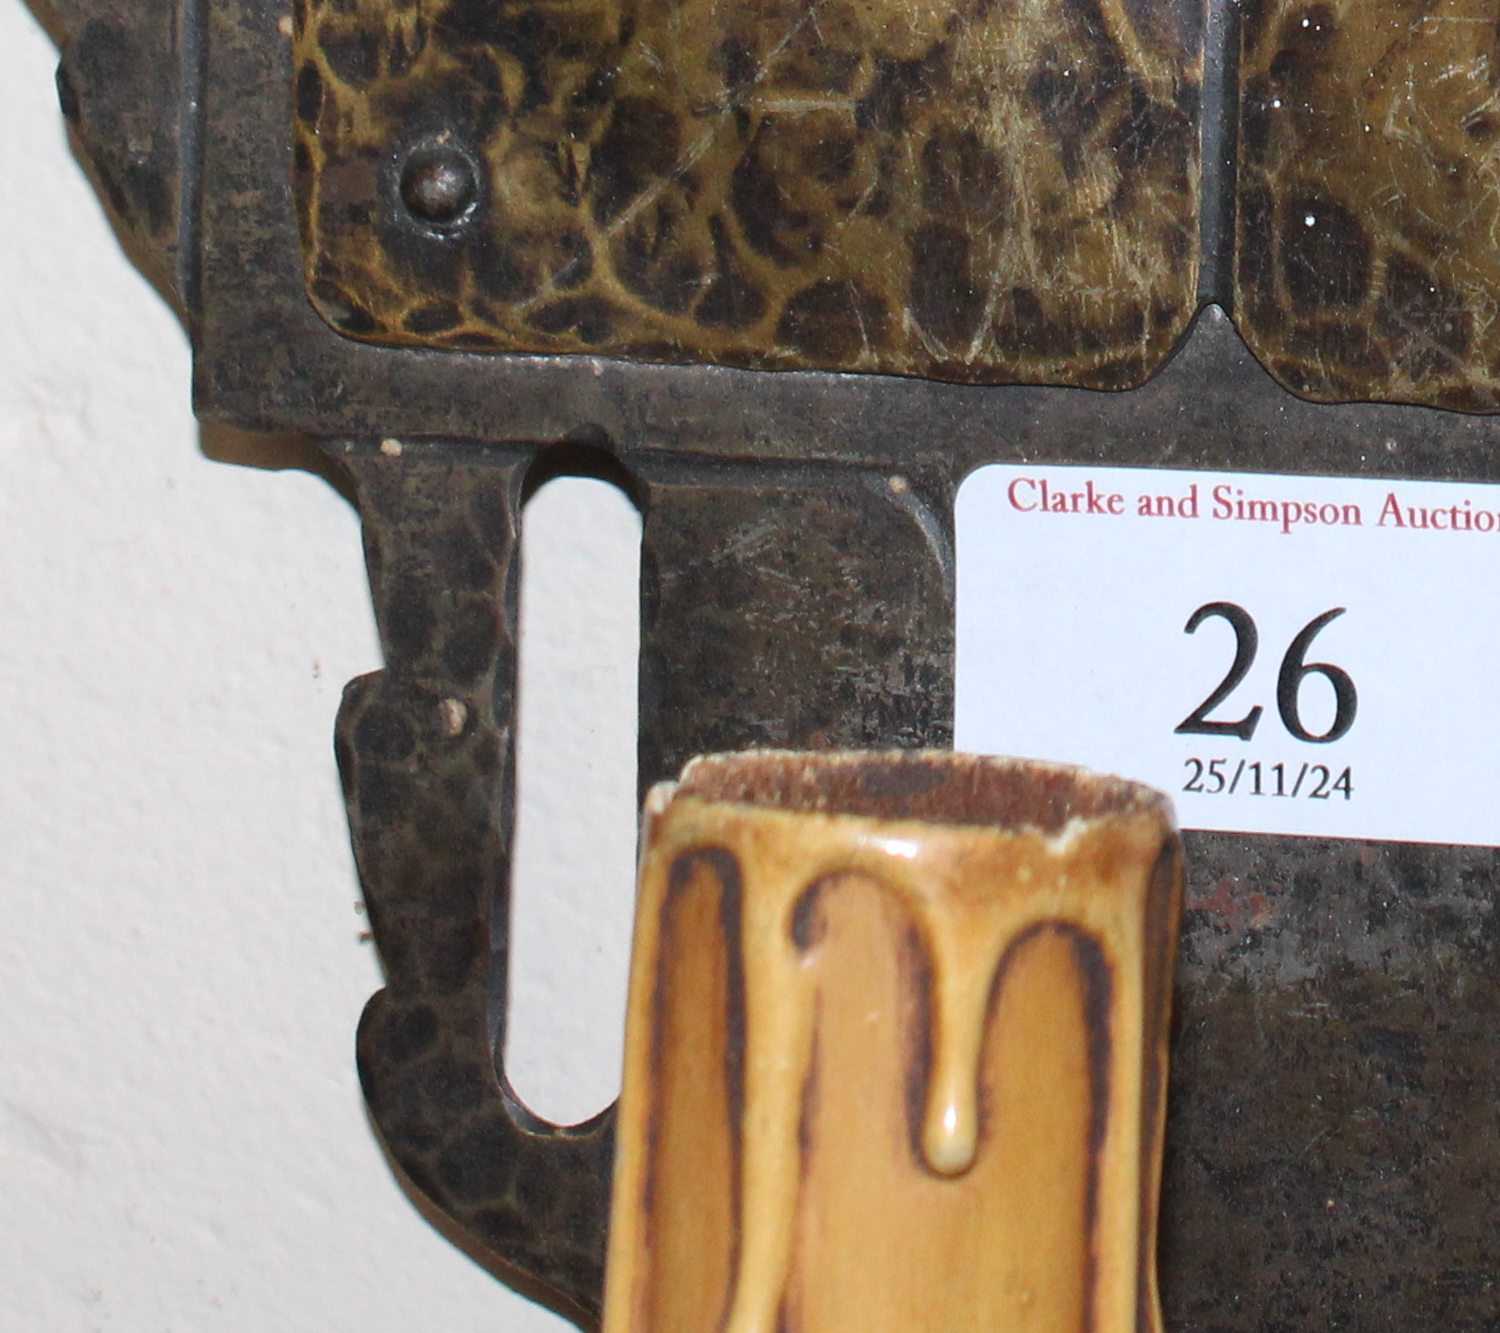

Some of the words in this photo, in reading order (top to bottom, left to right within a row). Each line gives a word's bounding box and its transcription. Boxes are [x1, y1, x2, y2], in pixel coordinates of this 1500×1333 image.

[1007, 478, 1125, 517] Clarke
[1137, 484, 1200, 519] and
[1212, 485, 1363, 535] Simpson
[1173, 601, 1358, 744] 26
[1182, 758, 1355, 801] 25/11/24
